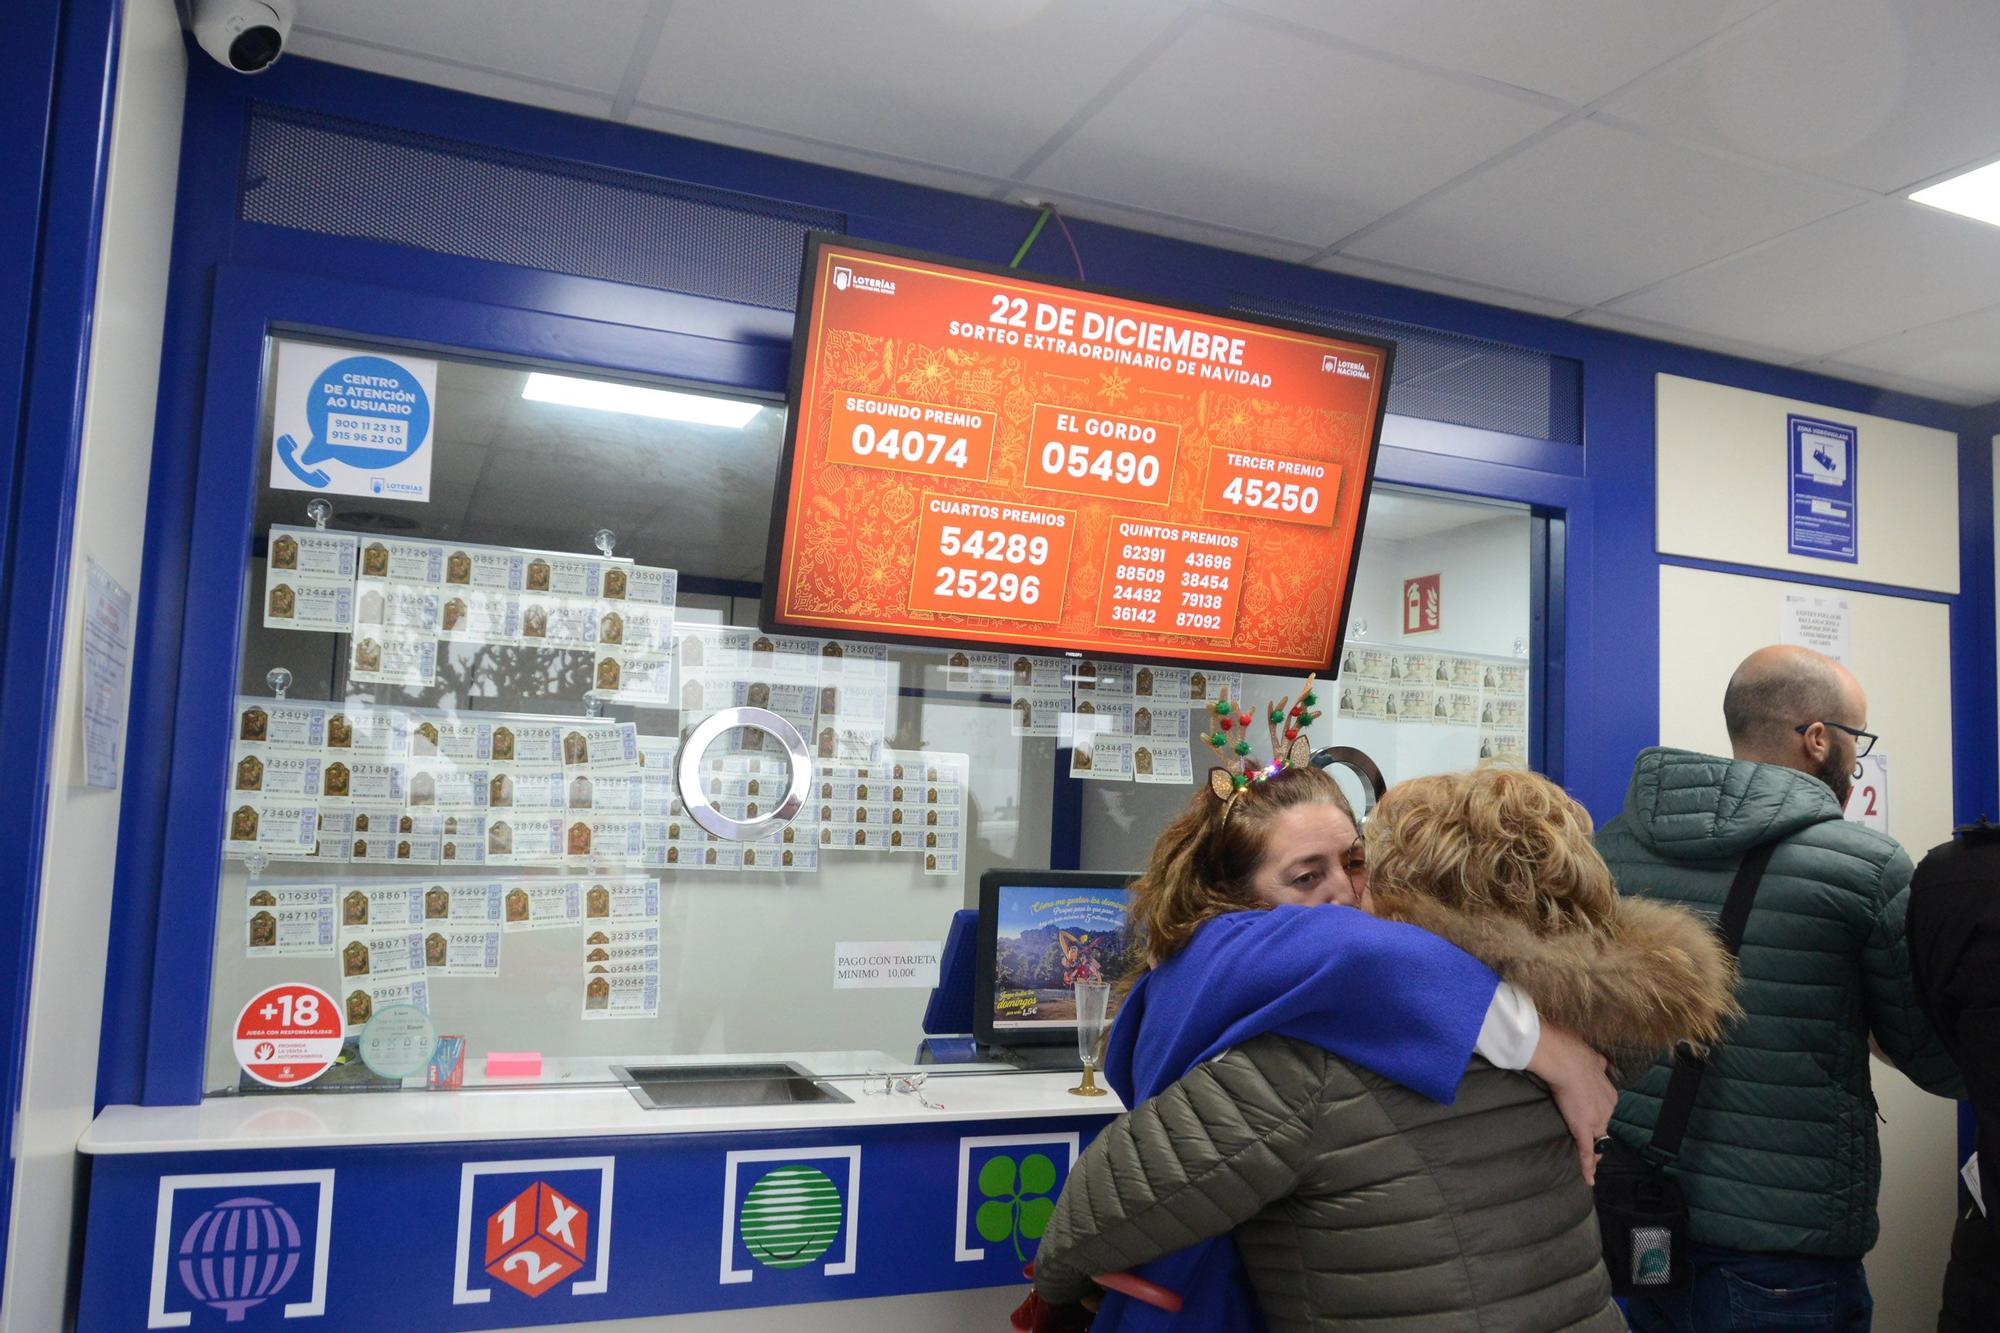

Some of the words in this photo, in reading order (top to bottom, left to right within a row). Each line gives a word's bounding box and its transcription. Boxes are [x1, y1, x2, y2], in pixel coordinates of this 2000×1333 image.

[853, 276, 896, 290] LOTERÍAS
[989, 295, 1027, 327] 22
[1034, 304, 1076, 335] DE
[1082, 312, 1247, 366] DICIEMBRE
[950, 320, 1019, 345] SORTEO
[1023, 333, 1171, 371] EXTRAORDINARIO
[1176, 360, 1195, 376] DE
[1200, 364, 1272, 388] NAVIDAD
[1338, 361, 1365, 371] LOTERÍA
[1337, 367, 1370, 379] NACIONAL
[343, 374, 399, 388] CENTRO
[324, 384, 343, 394] DE
[346, 387, 415, 403] ATENCIÓN
[327, 397, 347, 407] AO
[351, 401, 411, 415] USUARIO
[846, 398, 921, 420] SEGUNDO
[924, 409, 982, 429] PREMIO
[336, 420, 357, 429] 900
[362, 422, 370, 430] 11
[374, 423, 386, 431] 23
[390, 425, 400, 433] 13
[1056, 414, 1079, 433] EL
[1085, 419, 1157, 444] GORDO
[332, 431, 350, 440] 915
[354, 433, 367, 441] 96
[371, 434, 384, 443] 23
[387, 436, 402, 445] 00
[852, 424, 967, 468] 04074
[1042, 441, 1159, 486] 05490
[1227, 453, 1275, 471] TERCER
[1278, 460, 1324, 478] PREMIO
[1223, 477, 1318, 514] 45250
[930, 500, 998, 520] CUARTOS
[1002, 508, 1065, 527] PREMIOS
[1119, 523, 1179, 541] QUINTOS
[1181, 530, 1238, 547] PREMIOS
[301, 538, 337, 549] 02444
[940, 526, 1048, 565] 54289
[391, 547, 428, 558] 01726
[1123, 545, 1165, 562] 62391
[1185, 553, 1232, 570] 43696
[473, 554, 508, 565] 08512
[1116, 565, 1165, 583] 88509
[1181, 573, 1228, 590] 38454
[934, 567, 1040, 604] 25296
[297, 587, 336, 598] 02444
[1113, 585, 1161, 603] 24492
[1182, 592, 1222, 609] 79138
[1112, 606, 1156, 623] 36142
[1176, 612, 1221, 630] 87092
[775, 641, 807, 650] 94710
[845, 645, 875, 654] 79500
[1096, 704, 1122, 712] 02444
[516, 729, 551, 737] 28786
[1153, 749, 1178, 757] 04347
[267, 759, 304, 769] 73409
[262, 809, 300, 818] 73409
[593, 825, 626, 833] 93585
[279, 892, 317, 900] 01630
[371, 891, 407, 900] 08861
[452, 887, 487, 896] 76202
[279, 912, 317, 921] 94710
[370, 938, 407, 950] 99071
[449, 935, 484, 944] 76202
[838, 957, 866, 966] PAGO
[869, 956, 890, 965] CON
[893, 955, 936, 965] TARJETA
[611, 965, 644, 974] 02444
[888, 968, 917, 978] 10,00€
[611, 979, 644, 987] 92044
[373, 986, 410, 998] 99071
[997, 998, 1037, 1009] domingos
[259, 995, 319, 1026] +18
[497, 1200, 517, 1245] 1
[545, 1194, 579, 1248] X
[503, 1251, 562, 1284] 2
